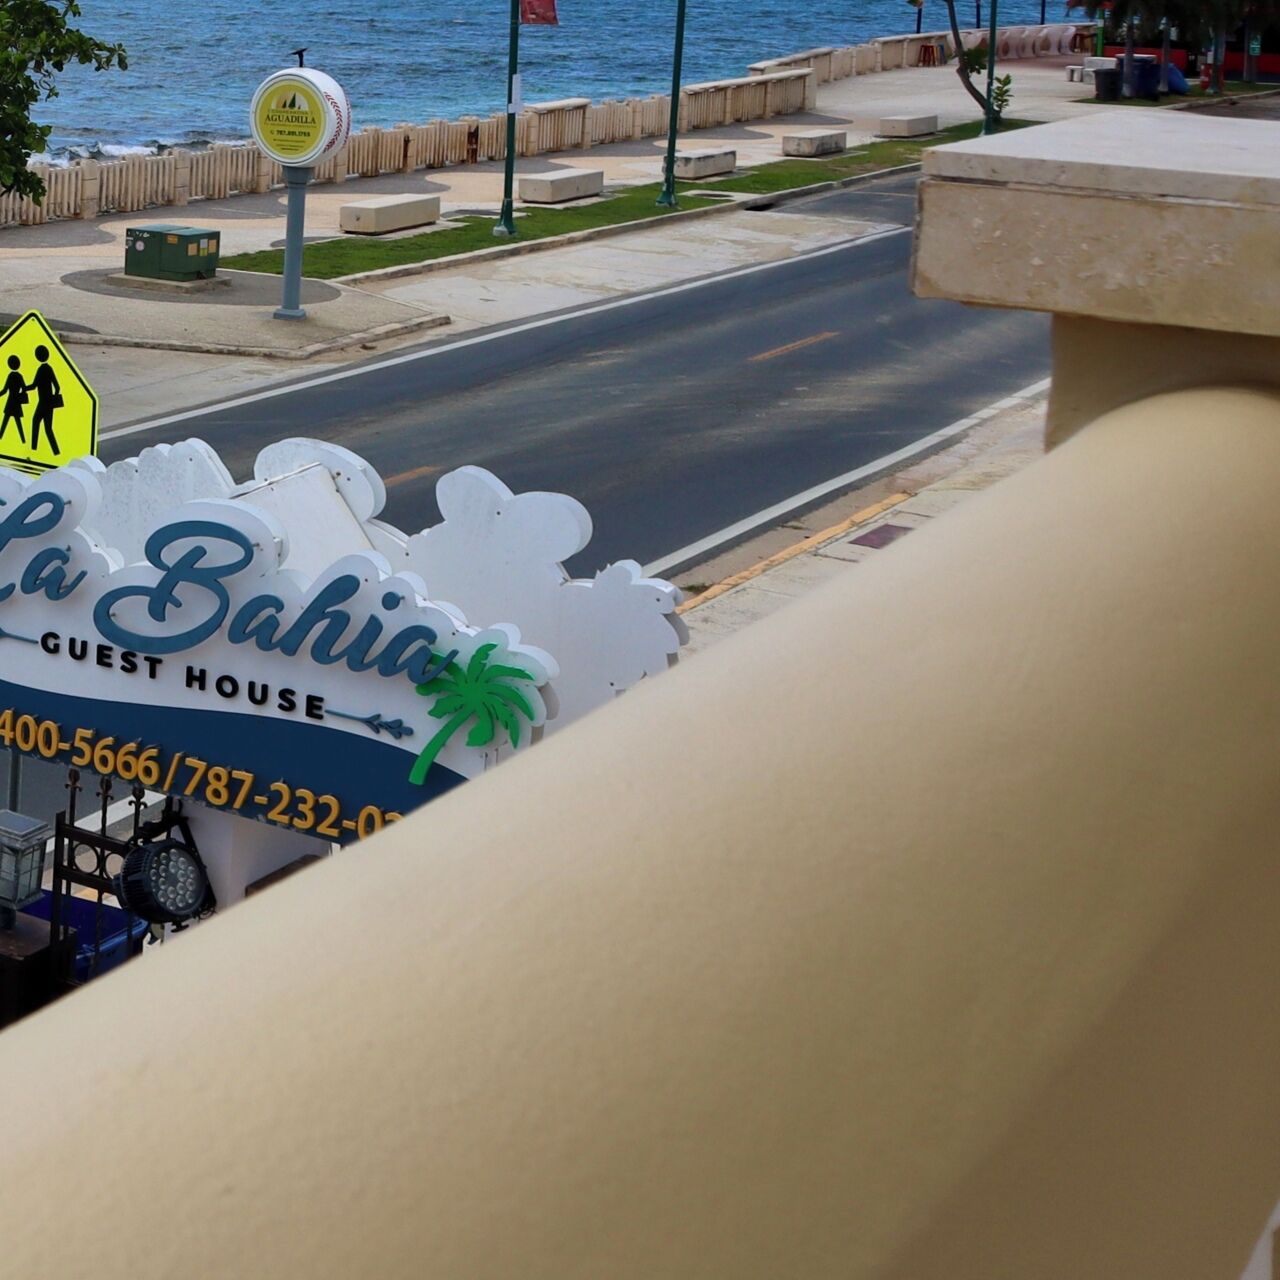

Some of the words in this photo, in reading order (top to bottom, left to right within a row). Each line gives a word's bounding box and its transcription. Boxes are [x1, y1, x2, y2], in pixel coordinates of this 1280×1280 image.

[265, 114, 317, 124] AGUADILLA
[92, 520, 460, 685] Bahia
[40, 631, 163, 679] GUEST
[184, 665, 325, 720] HOUSE
